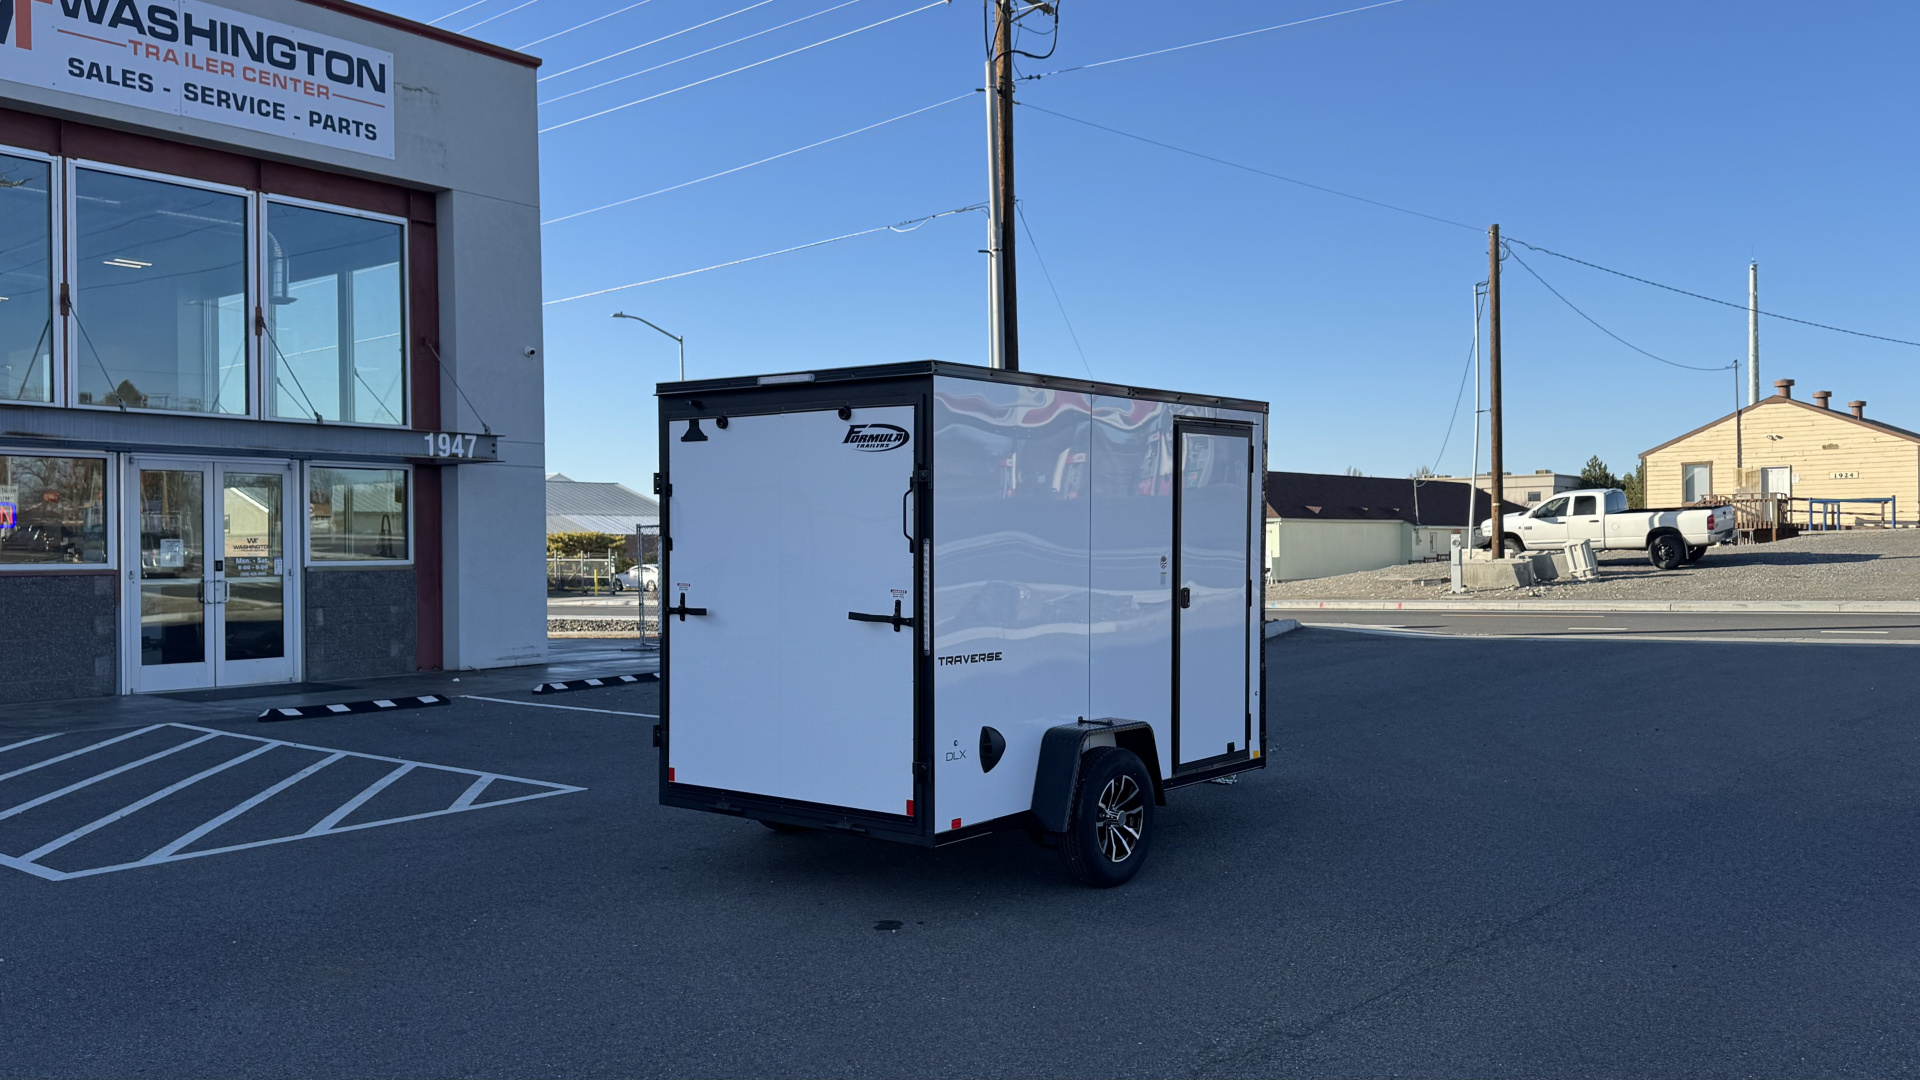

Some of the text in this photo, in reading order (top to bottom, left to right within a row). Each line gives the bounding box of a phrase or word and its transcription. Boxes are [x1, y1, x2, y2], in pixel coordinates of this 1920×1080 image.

[60, 0, 386, 94] WASHINGTON
[128, 39, 330, 100] TRAILER CENTER
[68, 57, 154, 93] SALES
[184, 82, 286, 121] SERVICE
[309, 110, 377, 141] PARTS
[424, 432, 477, 458] 1947
[842, 424, 904, 444] FORMULA
[938, 652, 1003, 666] TRAVERSE
[945, 750, 967, 761] DLX
